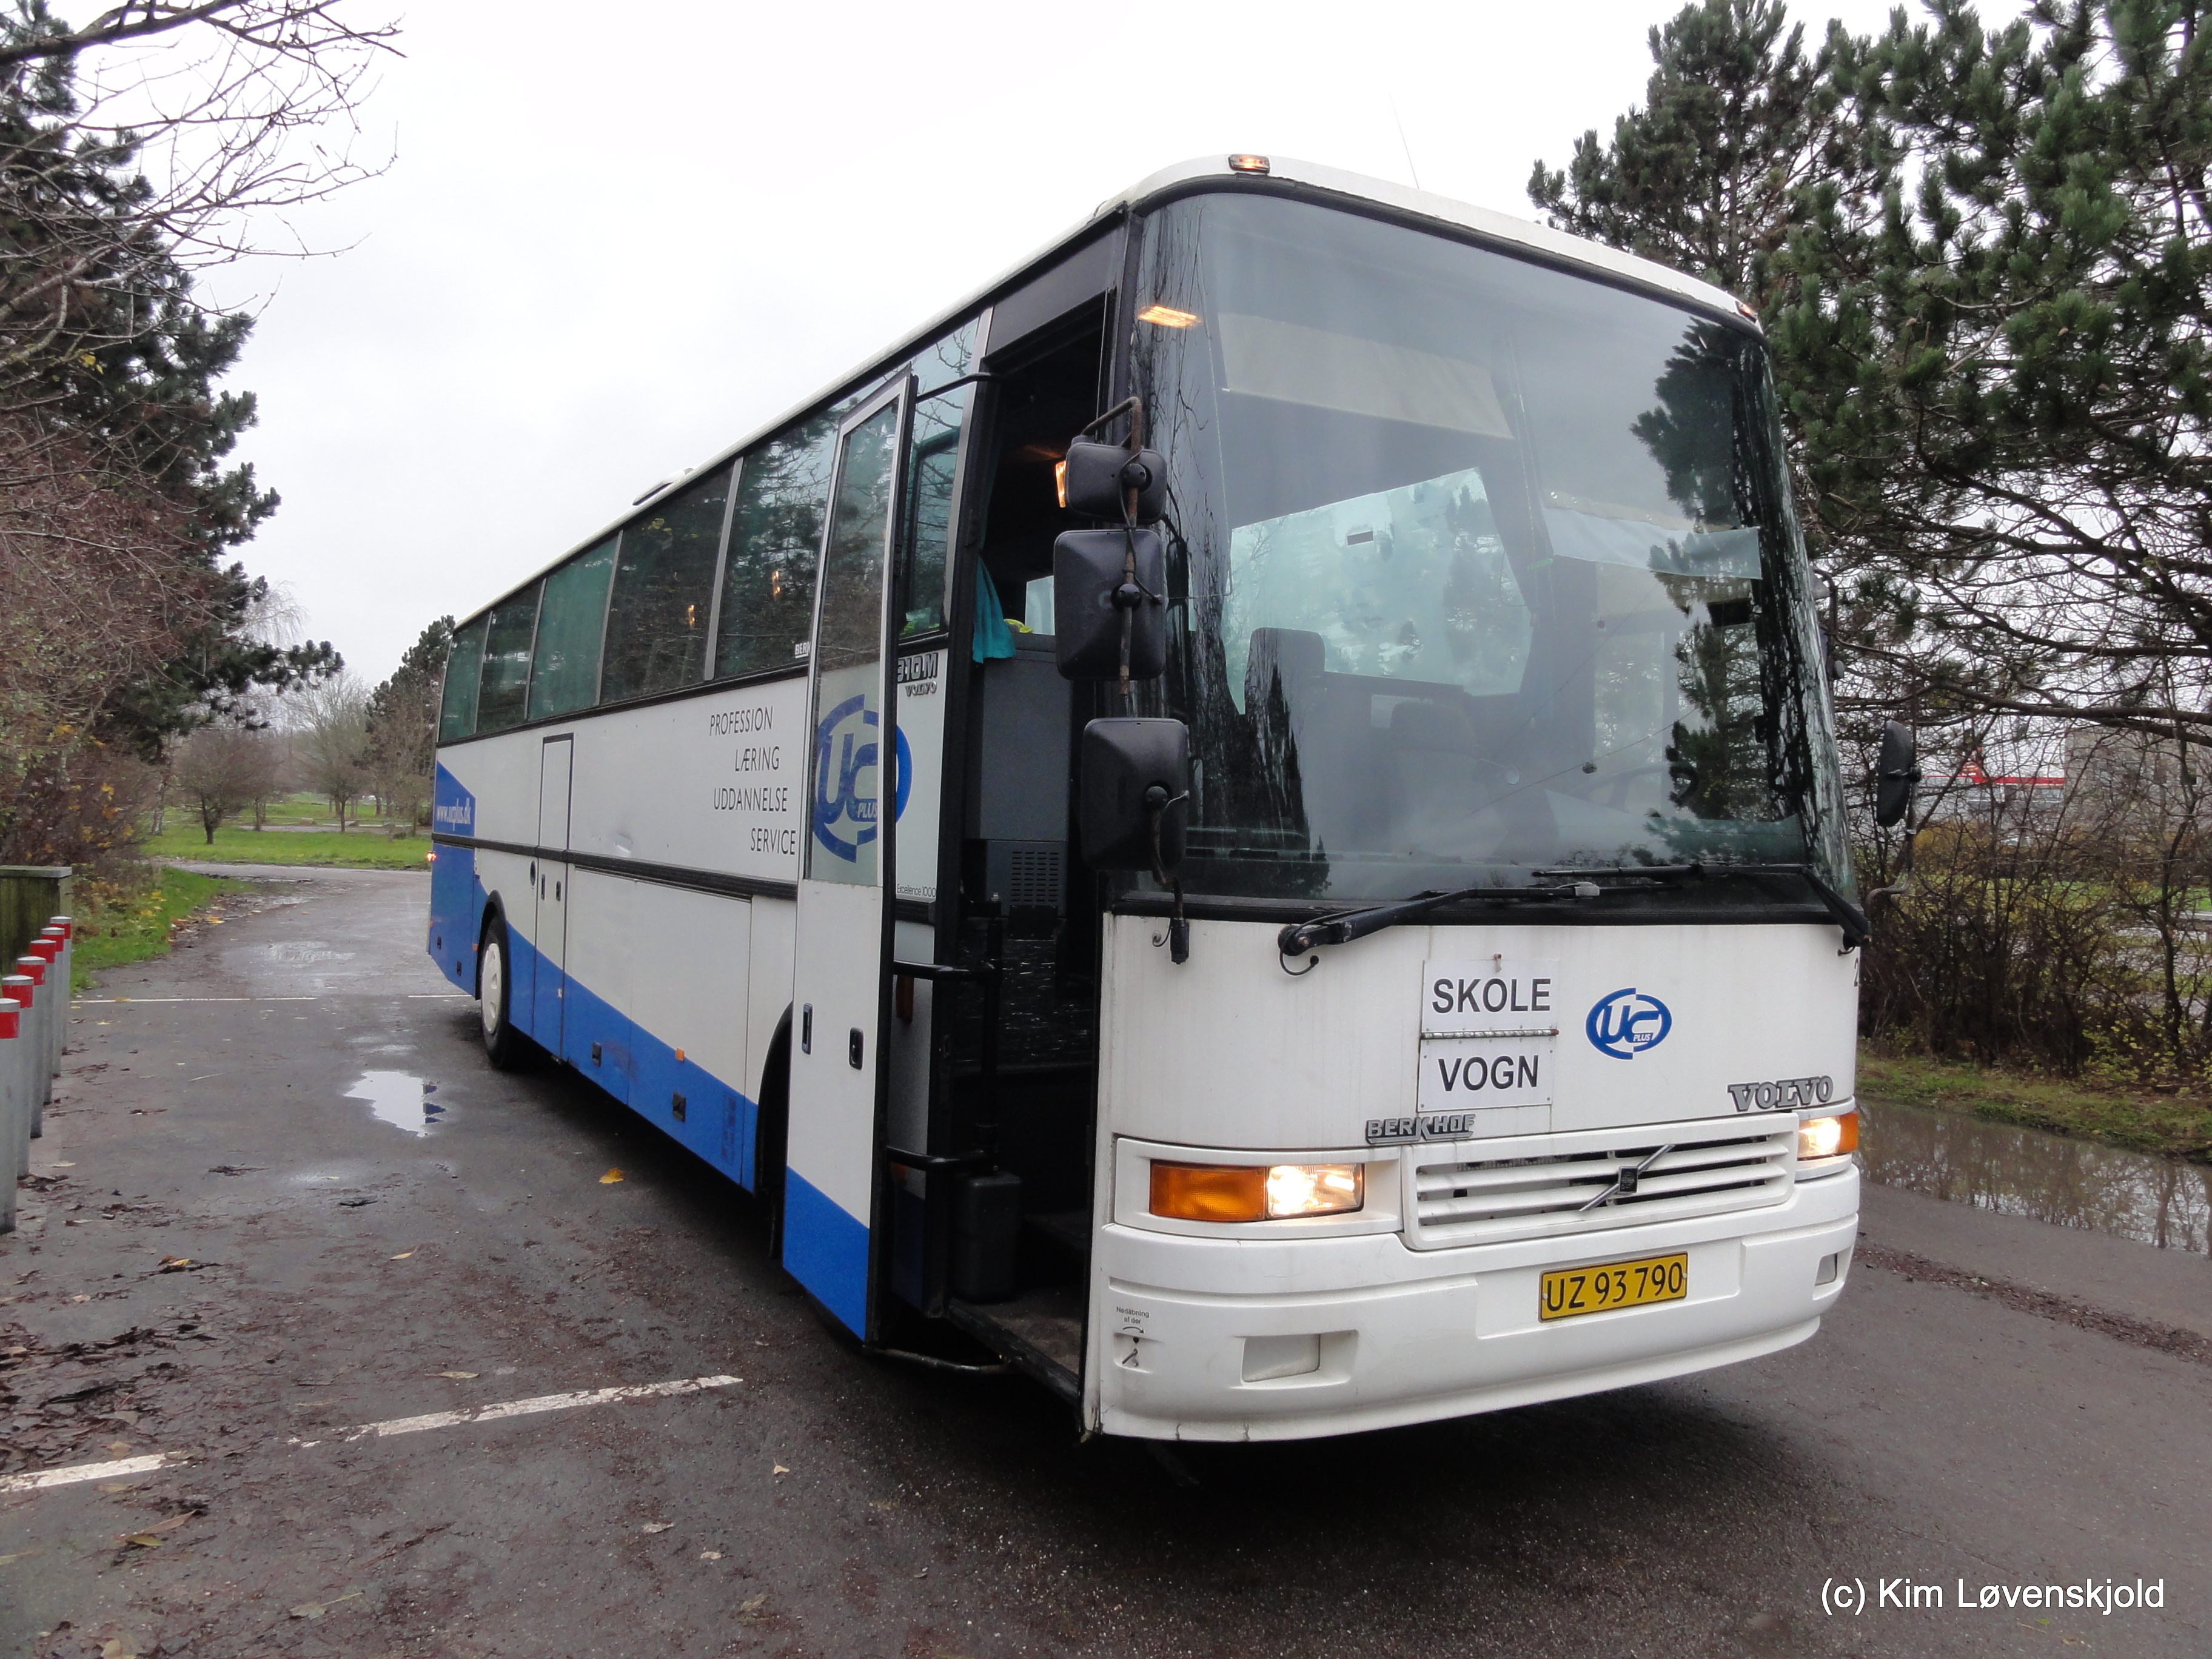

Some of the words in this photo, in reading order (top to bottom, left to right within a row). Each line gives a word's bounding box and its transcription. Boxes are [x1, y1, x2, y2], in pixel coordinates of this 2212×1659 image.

[905, 681, 937, 697] VOLVO
[709, 706, 773, 736] PROFESSION
[735, 746, 780, 772] LÆRING
[714, 787, 788, 812] UDDANNELSE
[857, 802, 878, 819] PLUS
[750, 827, 796, 855] SERVICE
[897, 883, 921, 896] Excellence
[922, 886, 936, 897] 1000
[1432, 978, 1551, 1013] SKOLE
[1632, 1033, 1651, 1042] PLUS
[1438, 1055, 1539, 1091] VOGN
[1727, 1075, 1834, 1112] VOLVO
[1366, 1114, 1476, 1145] BERKHOF
[1547, 1275, 1586, 1312] UZ
[1594, 1270, 1627, 1305] 93
[1634, 1262, 1683, 1299] 790
